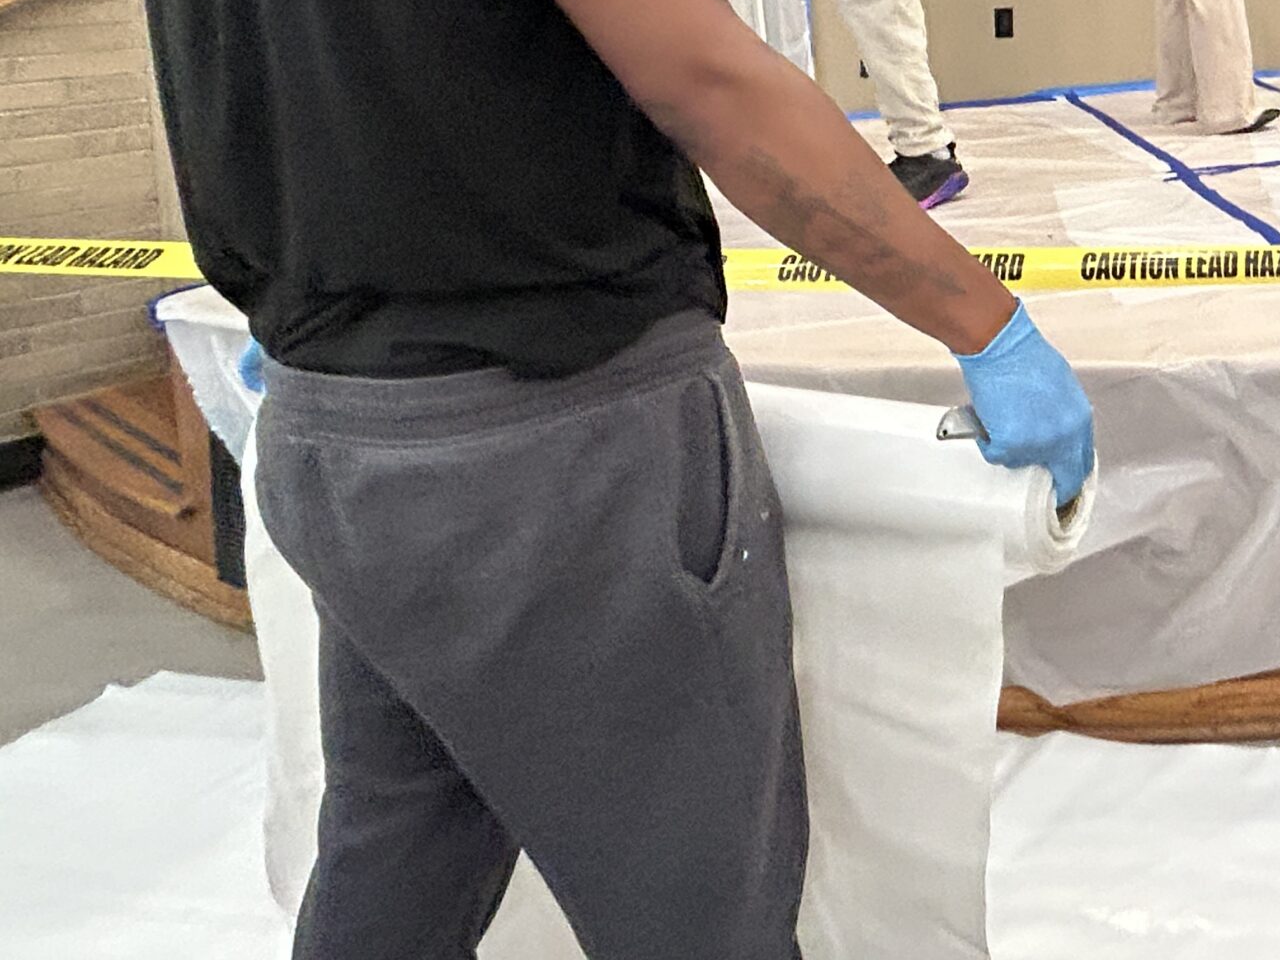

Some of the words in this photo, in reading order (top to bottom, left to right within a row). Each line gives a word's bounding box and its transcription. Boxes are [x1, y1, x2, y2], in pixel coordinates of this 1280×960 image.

[14, 245, 80, 266] LEAD
[66, 246, 164, 269] HAZARD
[1080, 251, 1179, 281] CAUTION
[1185, 249, 1238, 279] LEAD
